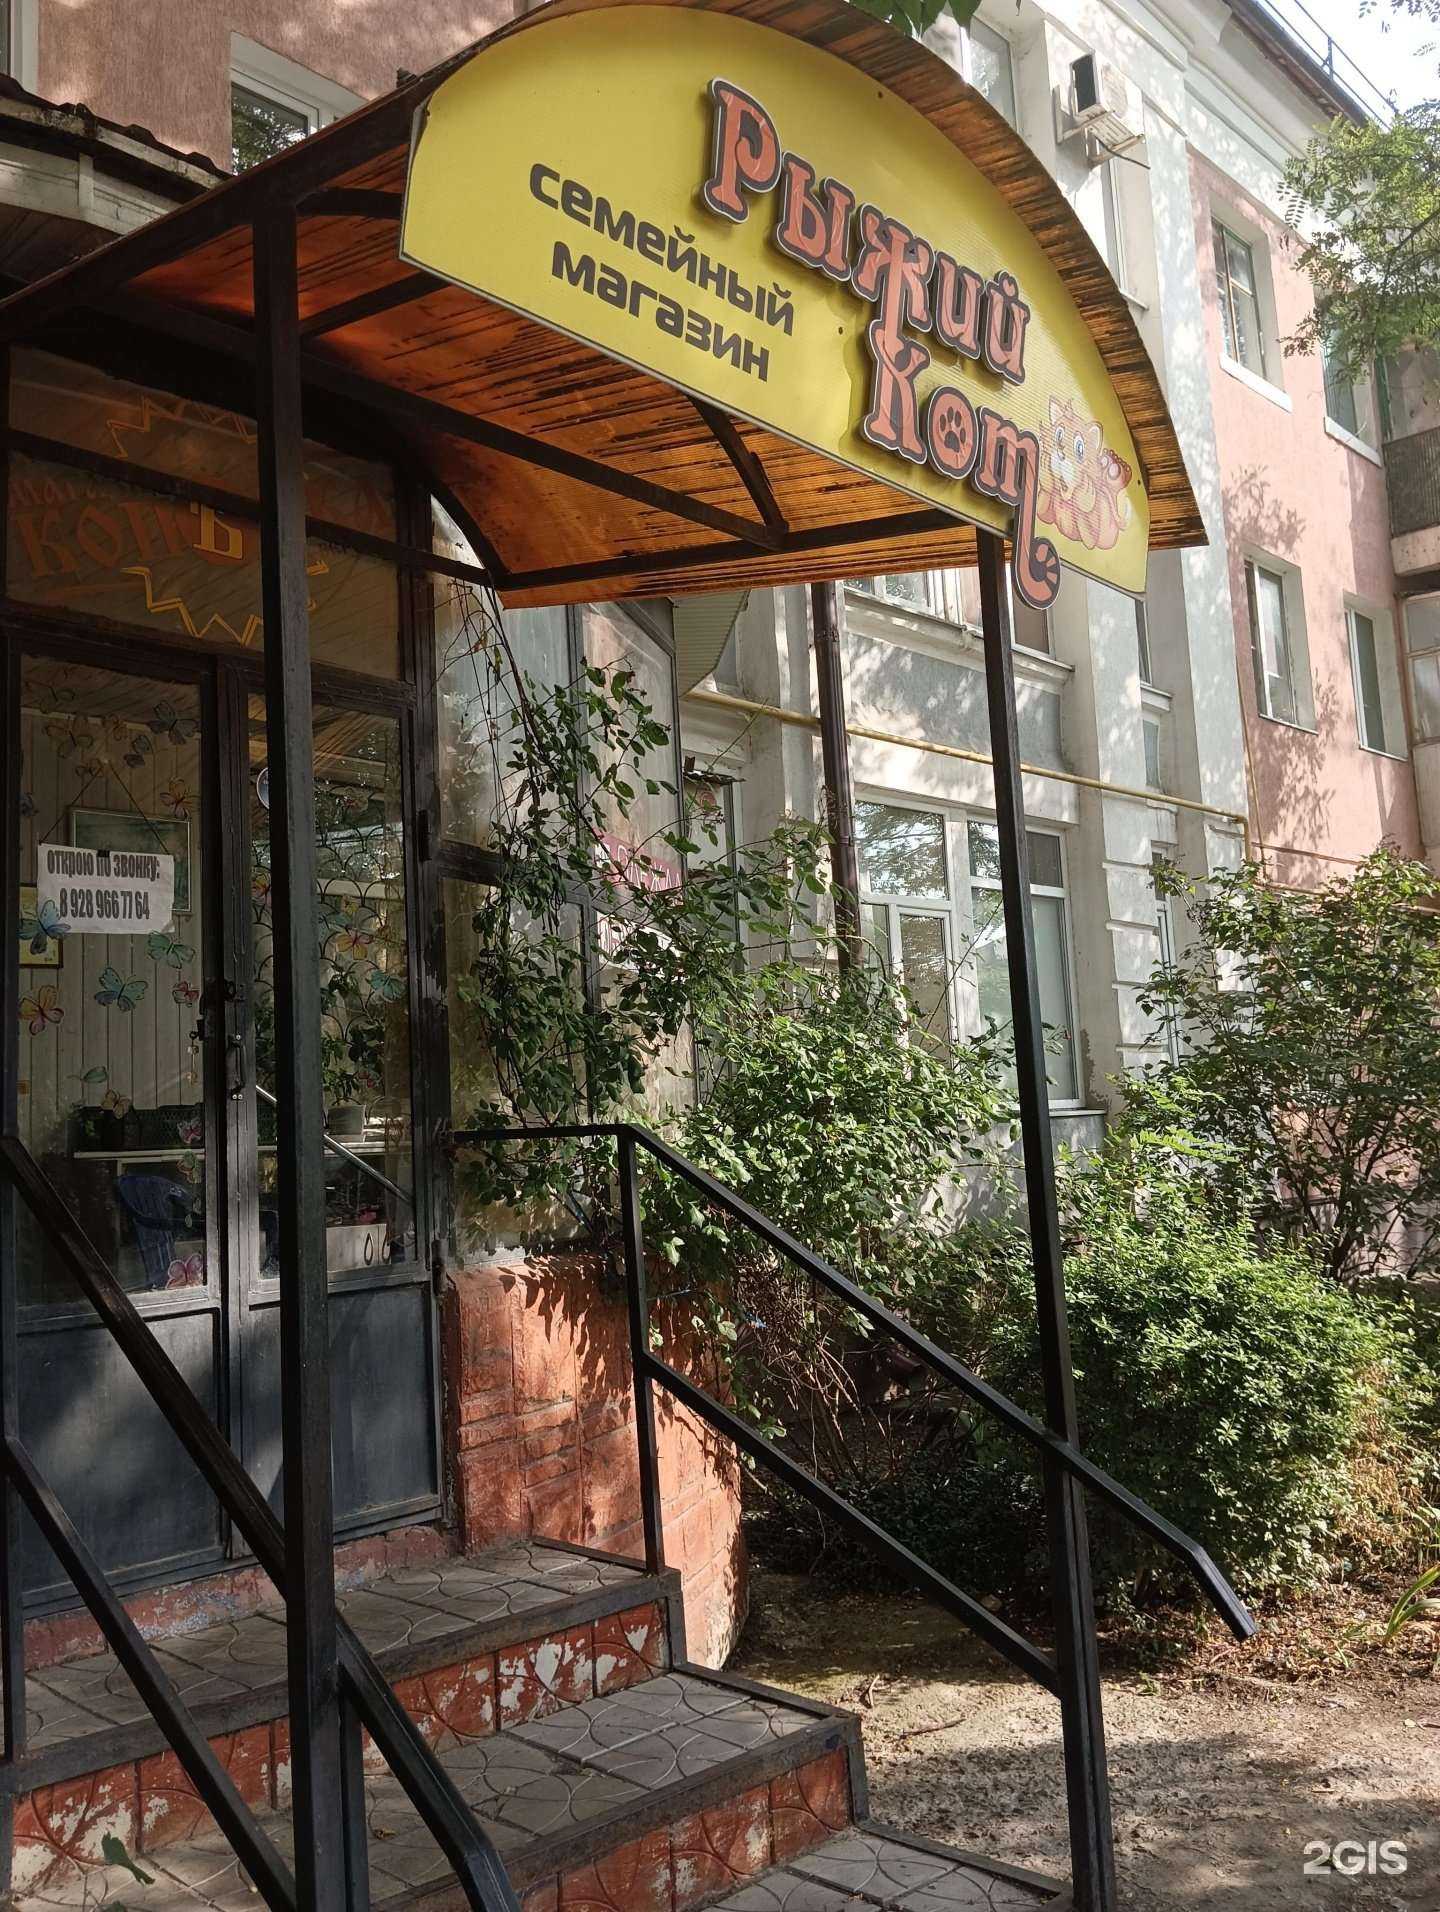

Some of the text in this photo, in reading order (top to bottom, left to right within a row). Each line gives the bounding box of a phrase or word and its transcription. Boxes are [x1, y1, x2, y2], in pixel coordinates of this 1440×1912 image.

[551, 241, 770, 382] магазин
[60, 888, 150, 920] 8 928 966 77 64
